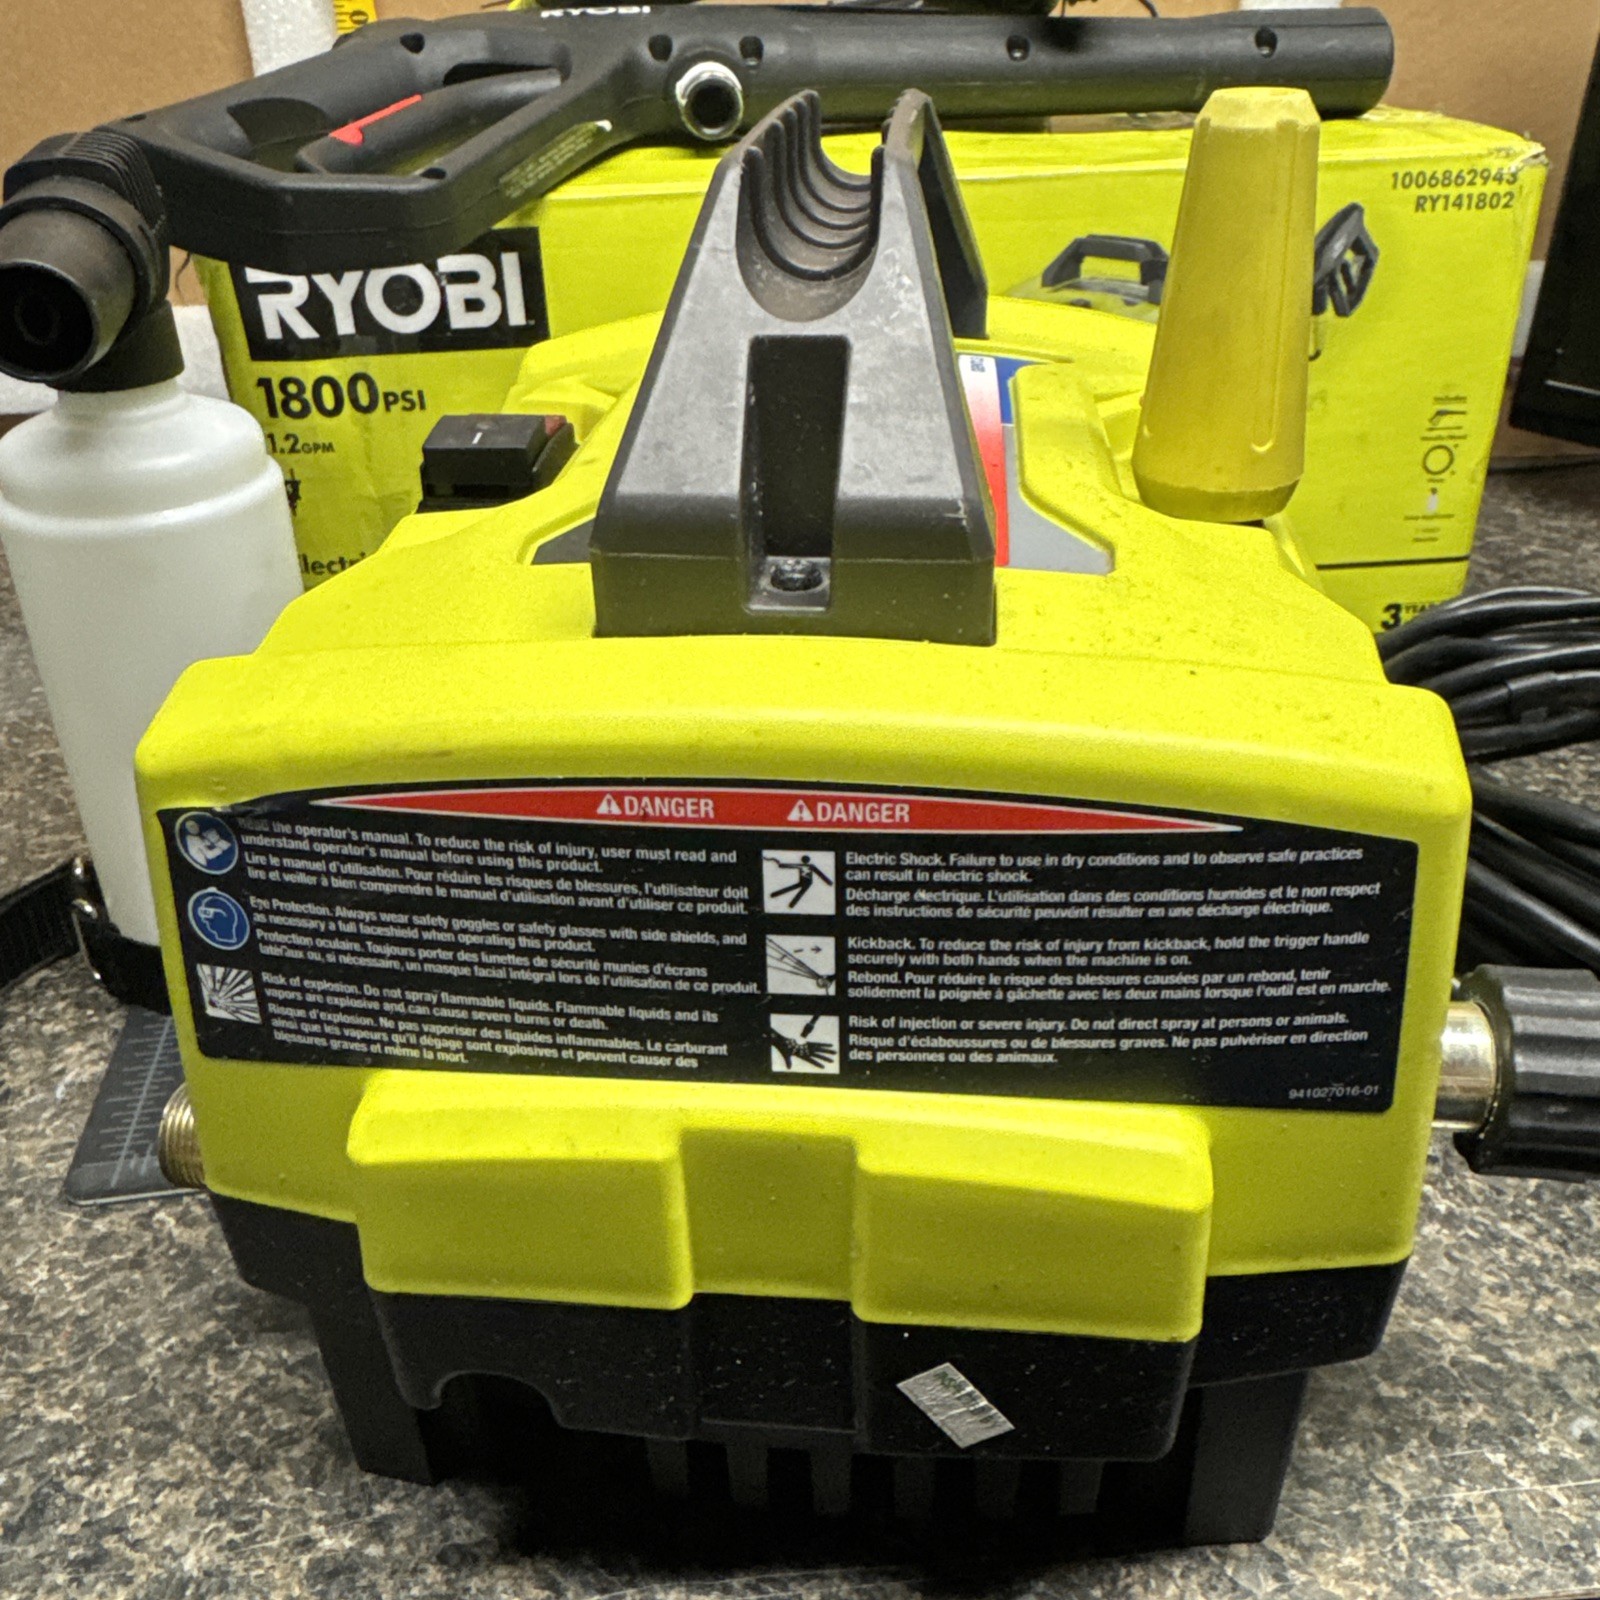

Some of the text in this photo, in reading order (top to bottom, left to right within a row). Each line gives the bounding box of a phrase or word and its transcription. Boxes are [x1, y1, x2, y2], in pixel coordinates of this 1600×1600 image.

[1391, 168, 1518, 190] 1006862943
[1415, 191, 1515, 213] RY141802
[245, 252, 527, 339] RYOBI
[623, 796, 715, 819] DANGER
[817, 803, 910, 823] DANGER
[241, 833, 603, 872] understand operator's manual before using this product.
[294, 824, 359, 841] operator's
[361, 831, 413, 845] manual.
[415, 832, 431, 846] To
[434, 835, 480, 850] reduce
[483, 837, 505, 851] the
[508, 839, 535, 853] risk
[537, 841, 551, 854] of
[555, 842, 598, 859] injury,
[600, 847, 631, 858] user
[635, 847, 670, 860] must
[674, 849, 706, 862] read
[710, 850, 737, 863] and
[845, 847, 1363, 869] Electric Shock. Failure to use in dry conditions and to observe safe practices
[243, 851, 267, 865] Lire
[268, 853, 280, 866] le
[282, 857, 326, 872] manuel
[328, 860, 403, 878] d'utilisation.
[404, 866, 433, 881] Pour
[483, 872, 503, 886] les
[505, 874, 553, 891] risques
[555, 877, 572, 891] de
[574, 878, 642, 896] blessures,
[644, 882, 719, 898] l'utilisateur
[722, 886, 748, 899] doit
[844, 868, 1032, 882] can result in electric shock.
[845, 887, 910, 904] Décharge
[1068, 889, 1102, 902] dans
[1105, 889, 1130, 902] des
[1133, 888, 1204, 902] conditions
[1207, 886, 1267, 900] humides
[1268, 885, 1283, 899] et
[1285, 885, 1299, 898] le
[1301, 886, 1327, 897] non
[1329, 881, 1381, 898] respect
[451, 918, 747, 945] goggles or safety glasses with side shields, and
[847, 931, 1370, 953] Kickback. To reduce the risk of injury from kickback, hold the trigger handle
[847, 952, 1191, 967] securely with both hands when the machine is on.
[847, 967, 1331, 987] Rebond. Pour réduire le risque des blessures causées par un rebond, tenir
[555, 1000, 718, 1022] Flammable liquids and its
[848, 1011, 1349, 1032] Risk of injection or severe injury. Do not direct spray at persons or animals.
[848, 1029, 1368, 1050] Risque d'éclaboussures ou de blessures graves. Ne pas pulvériser en direction
[848, 1048, 1057, 1063] des personnes ou des animaux.
[1289, 1085, 1379, 1099] 941027016-01
